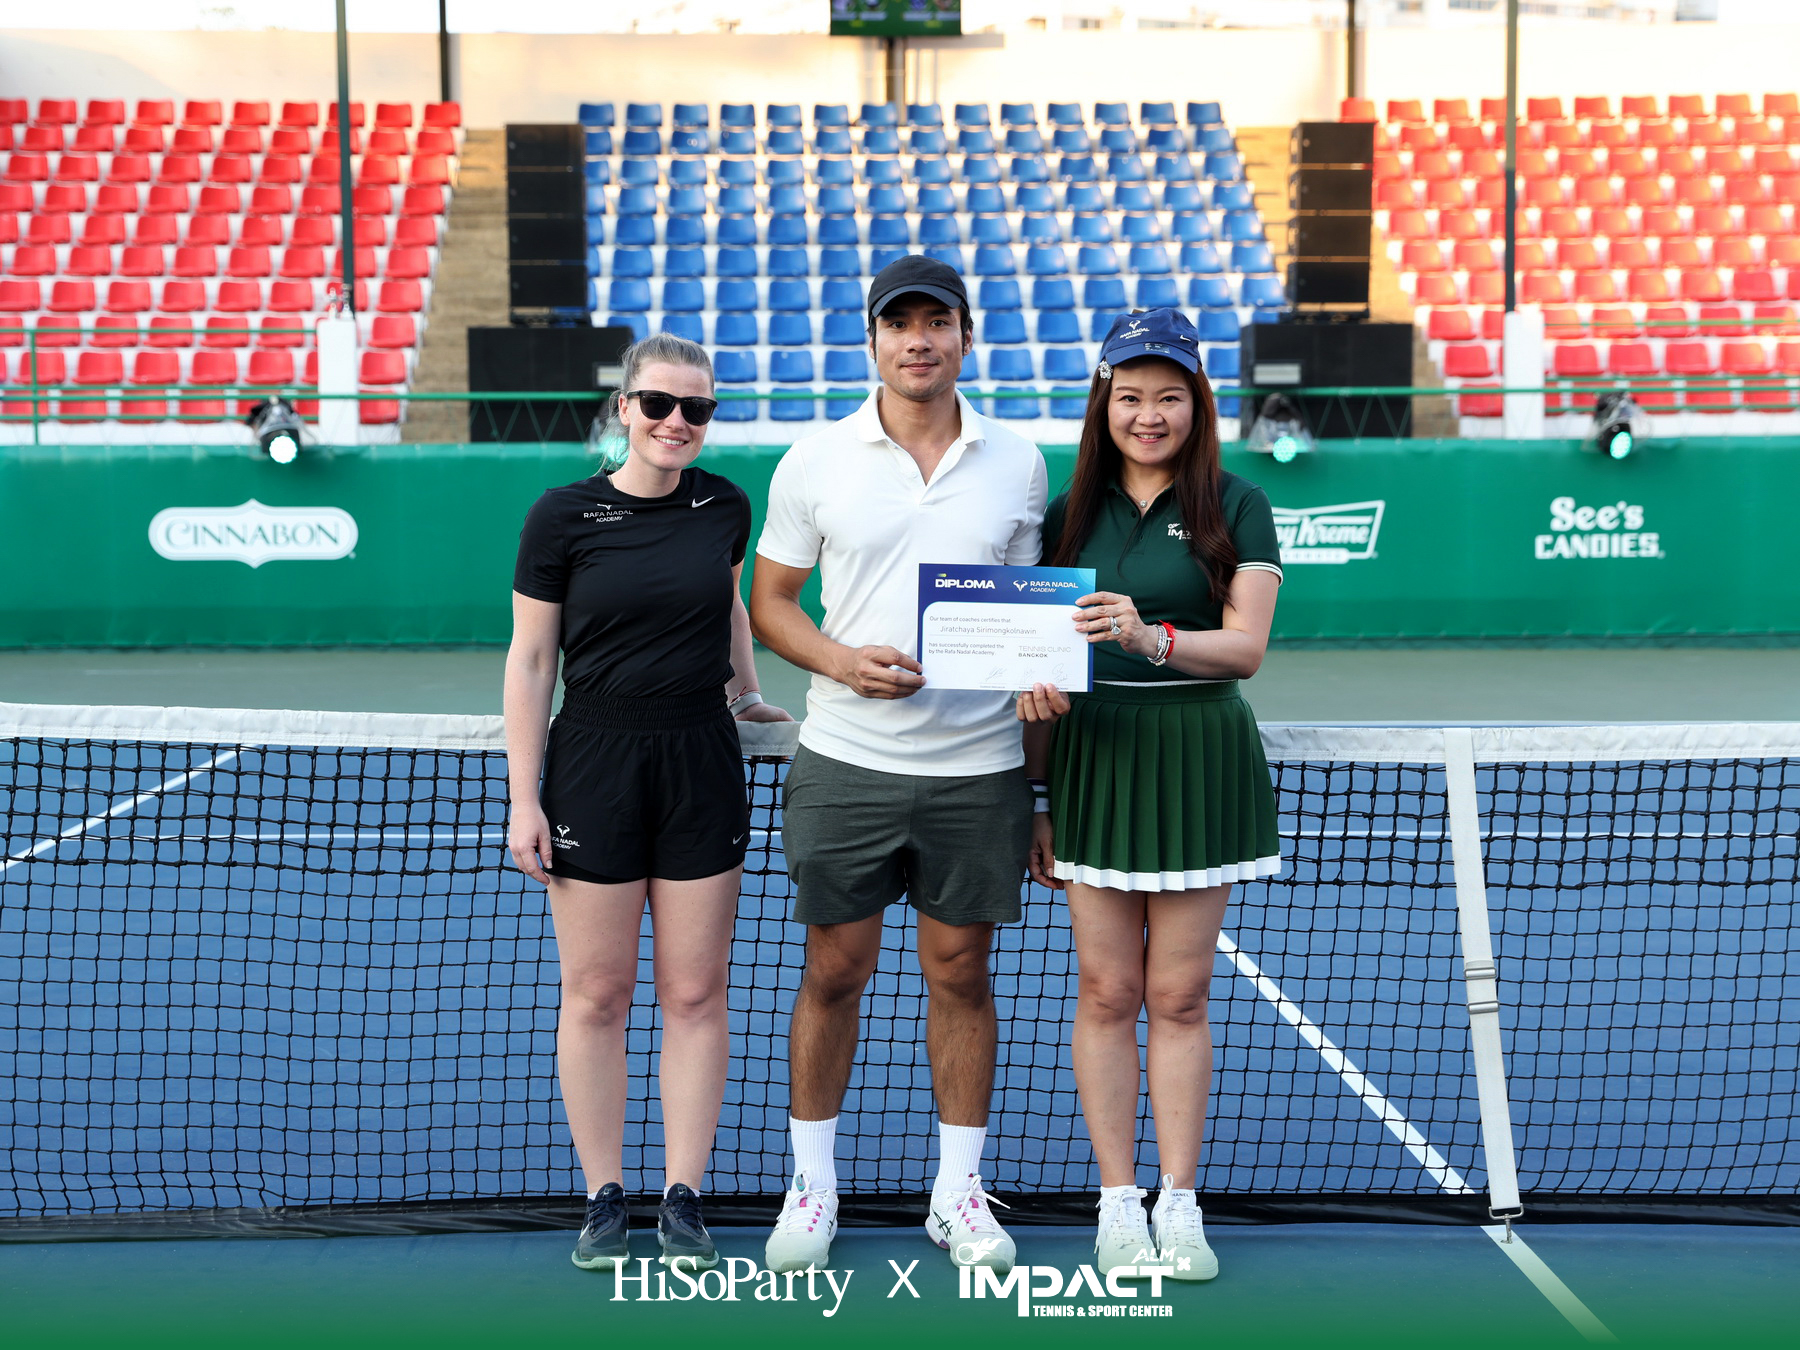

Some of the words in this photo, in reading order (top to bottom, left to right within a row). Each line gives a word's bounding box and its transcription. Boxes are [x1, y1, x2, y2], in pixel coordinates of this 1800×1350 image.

[583, 511, 605, 519] RAFA
[1550, 496, 1644, 532] See's
[165, 519, 340, 549] CINNABON
[1297, 515, 1372, 546] Kreme
[1534, 532, 1660, 559] CANDIES
[935, 578, 995, 589] DIPLOMA
[1030, 580, 1051, 588] RAFA
[1051, 581, 1079, 589] NADAL
[940, 626, 975, 635] Jiratchaya
[976, 626, 1037, 636] Sirimongkolnawin
[560, 838, 580, 846] NADAL
